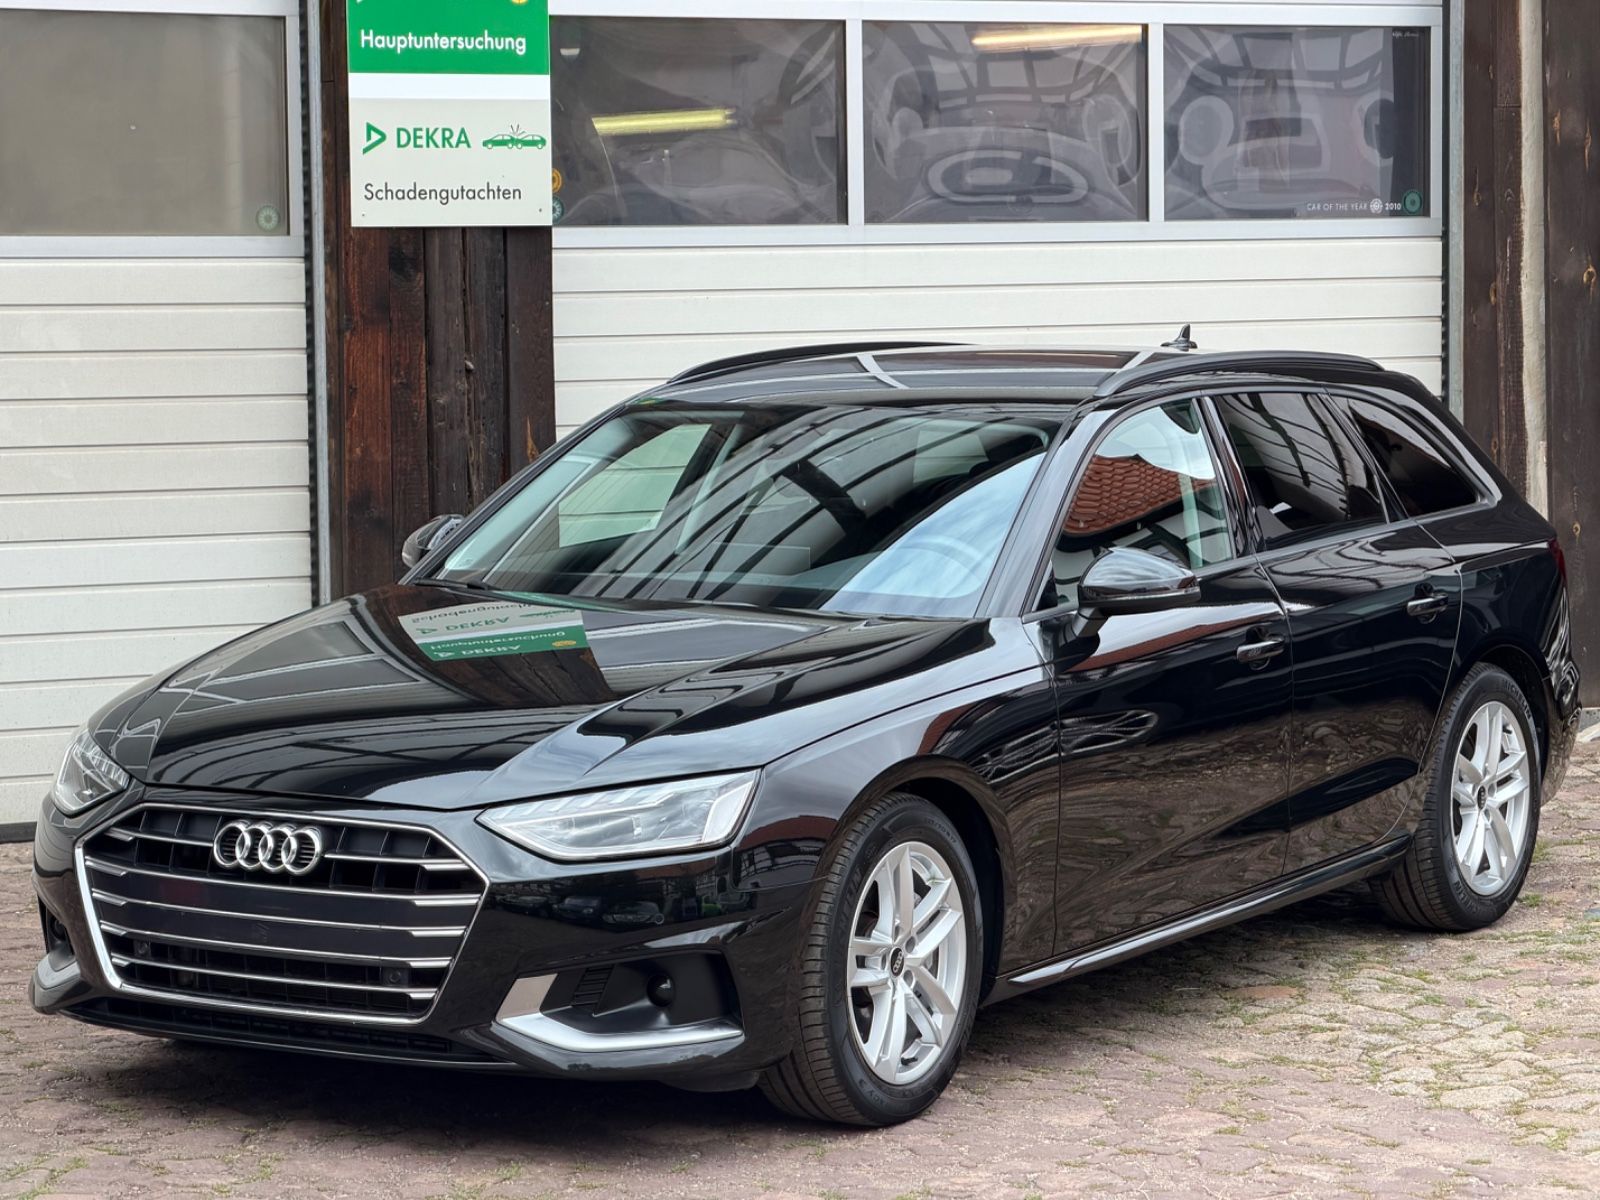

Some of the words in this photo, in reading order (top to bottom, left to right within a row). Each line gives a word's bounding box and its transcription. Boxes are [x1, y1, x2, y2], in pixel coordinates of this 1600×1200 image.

[360, 29, 526, 55] Hauptuntersuchung
[396, 127, 472, 149] DEKRA
[364, 182, 522, 205] Schadengutachten
[1306, 202, 1321, 211] CAR
[1323, 202, 1333, 211] OF
[1335, 202, 1348, 211] THE
[1351, 202, 1367, 211] YEAR
[1385, 202, 1402, 211] 2010
